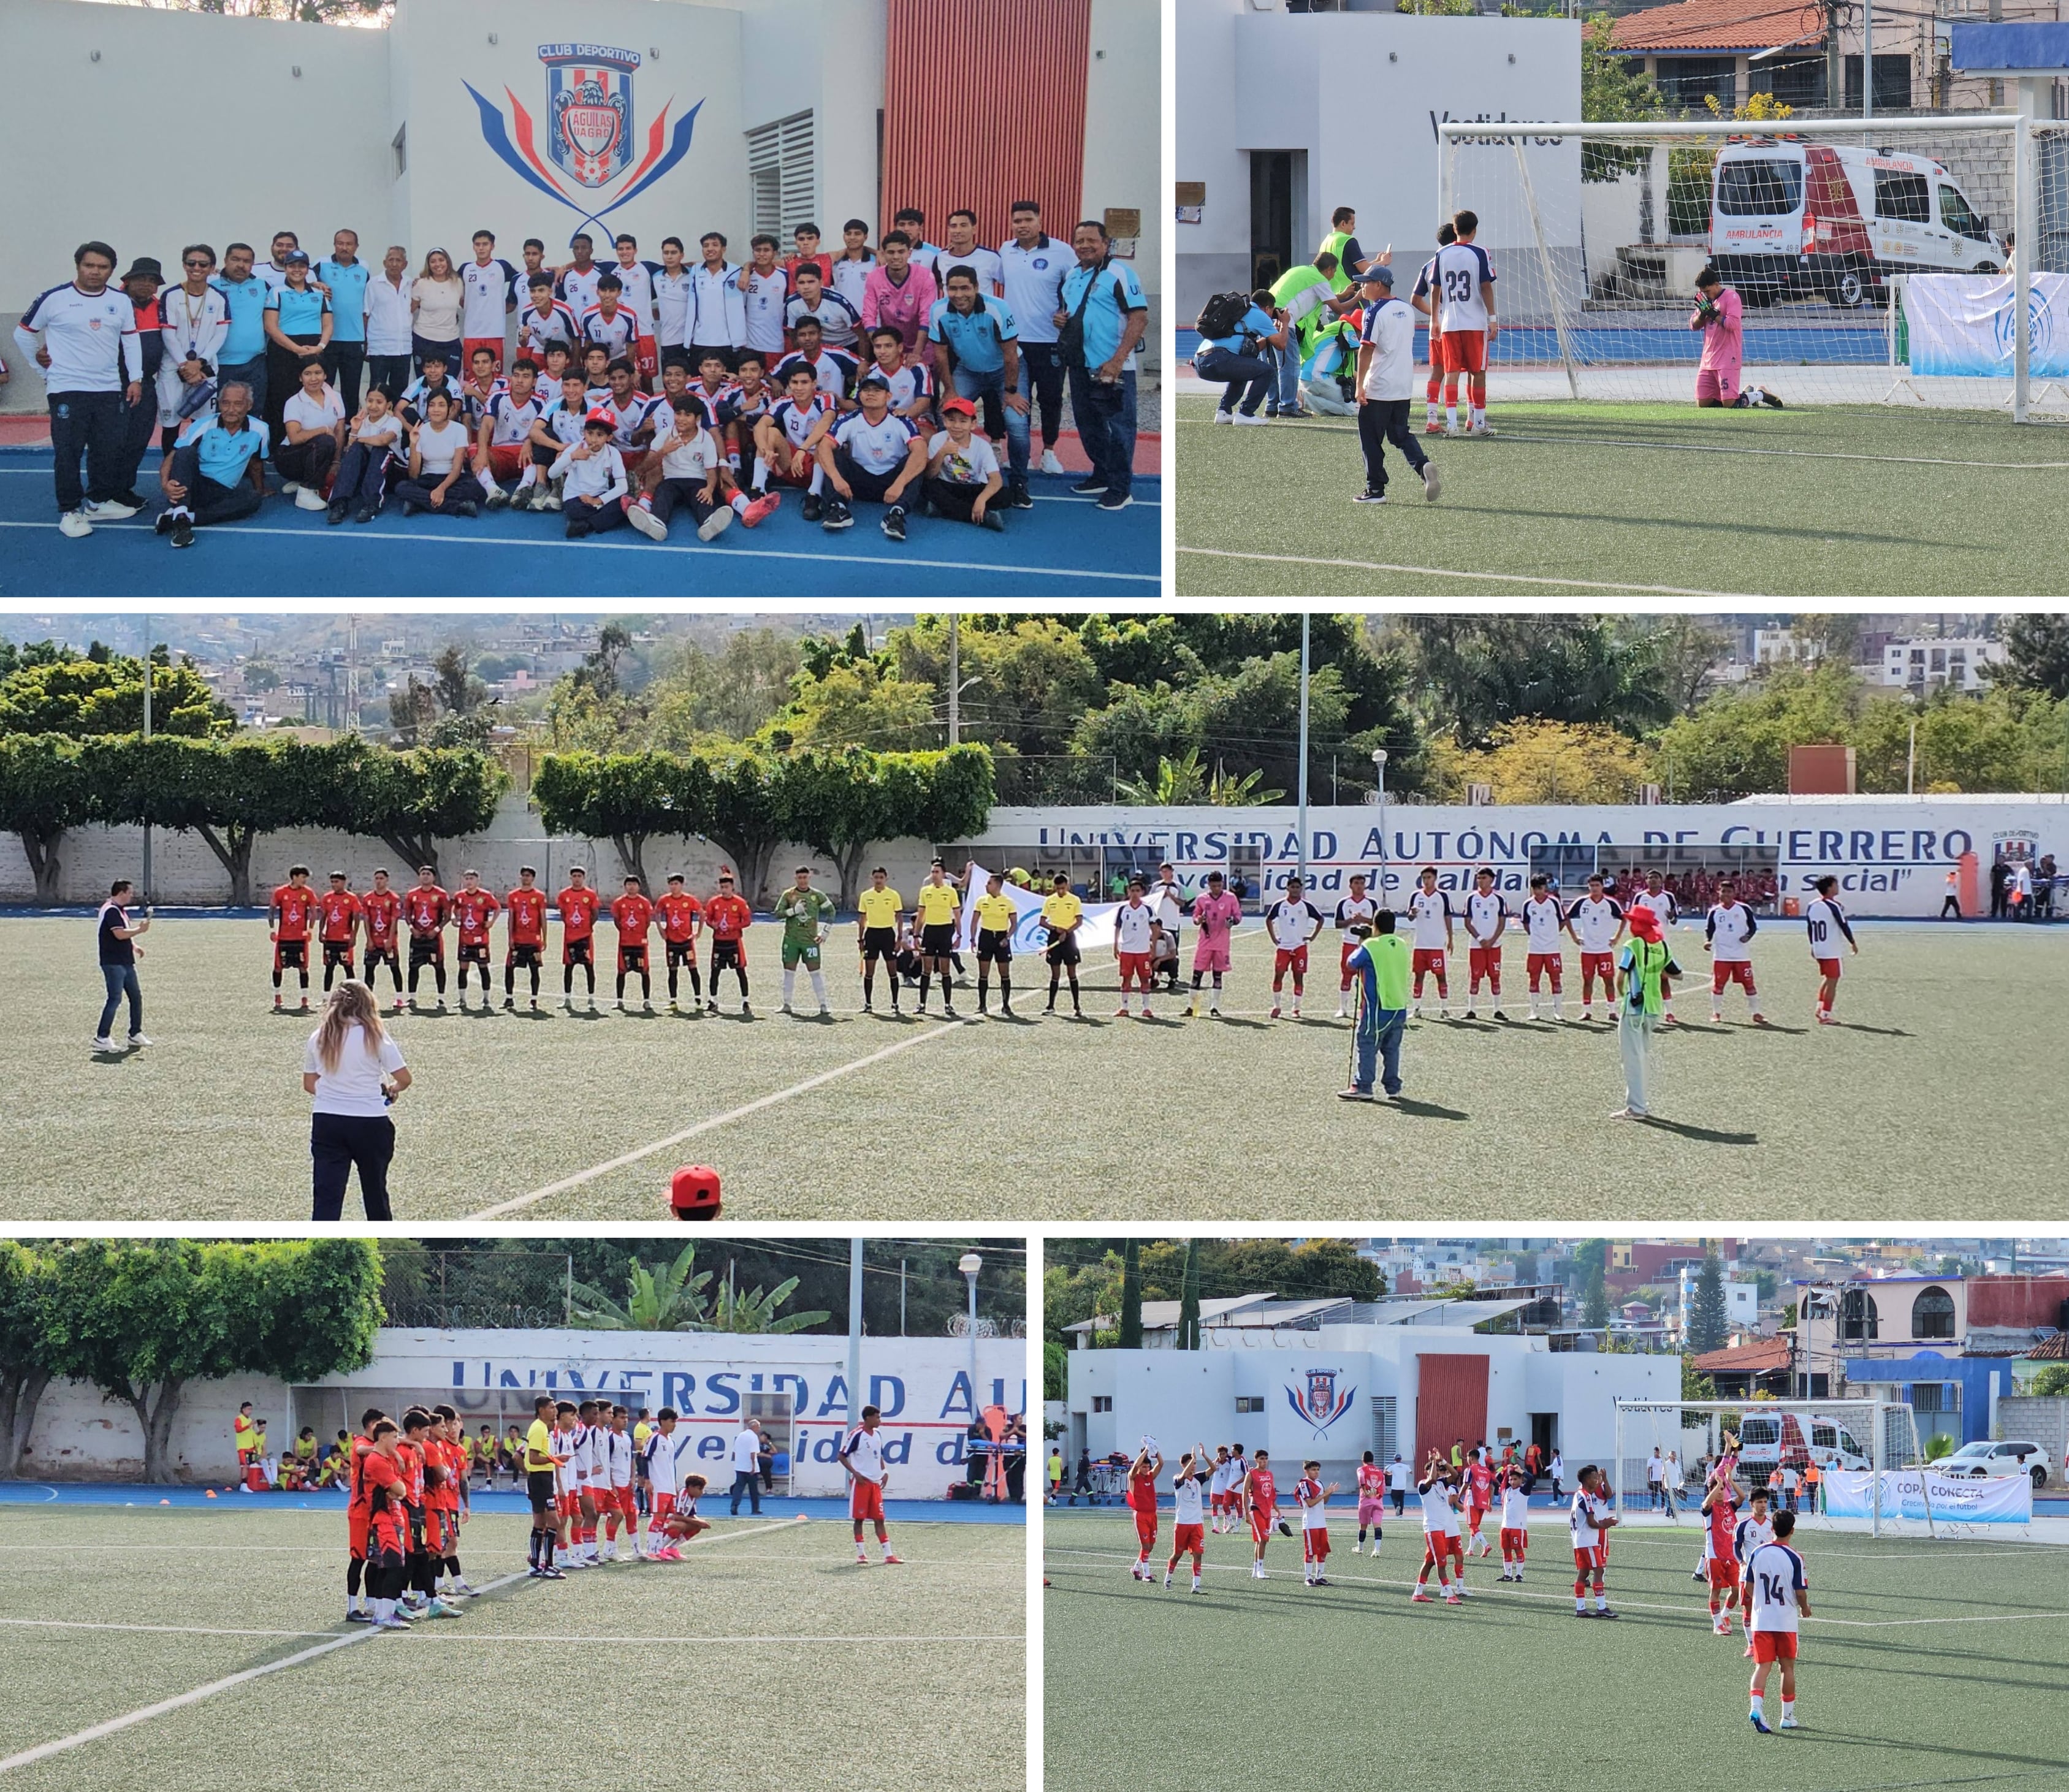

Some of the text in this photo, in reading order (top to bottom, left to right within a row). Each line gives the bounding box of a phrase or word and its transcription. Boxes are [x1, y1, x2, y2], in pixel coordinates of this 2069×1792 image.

[539, 45, 639, 64] CLUB DEPORTIVO
[574, 127, 610, 138] UAGRO
[1865, 157, 1914, 171] AMBULANCIA
[1726, 229, 1783, 240] AMBULANCIA
[748, 284, 758, 294] 22
[1445, 270, 1471, 302] 23
[641, 357, 654, 369] 37
[1644, 831, 1699, 860] DE
[1720, 826, 1972, 860] GUERRERO
[1812, 921, 1827, 942] 10
[1931, 1485, 1984, 1498] CONECTA
[1759, 1573, 1785, 1606] 14
